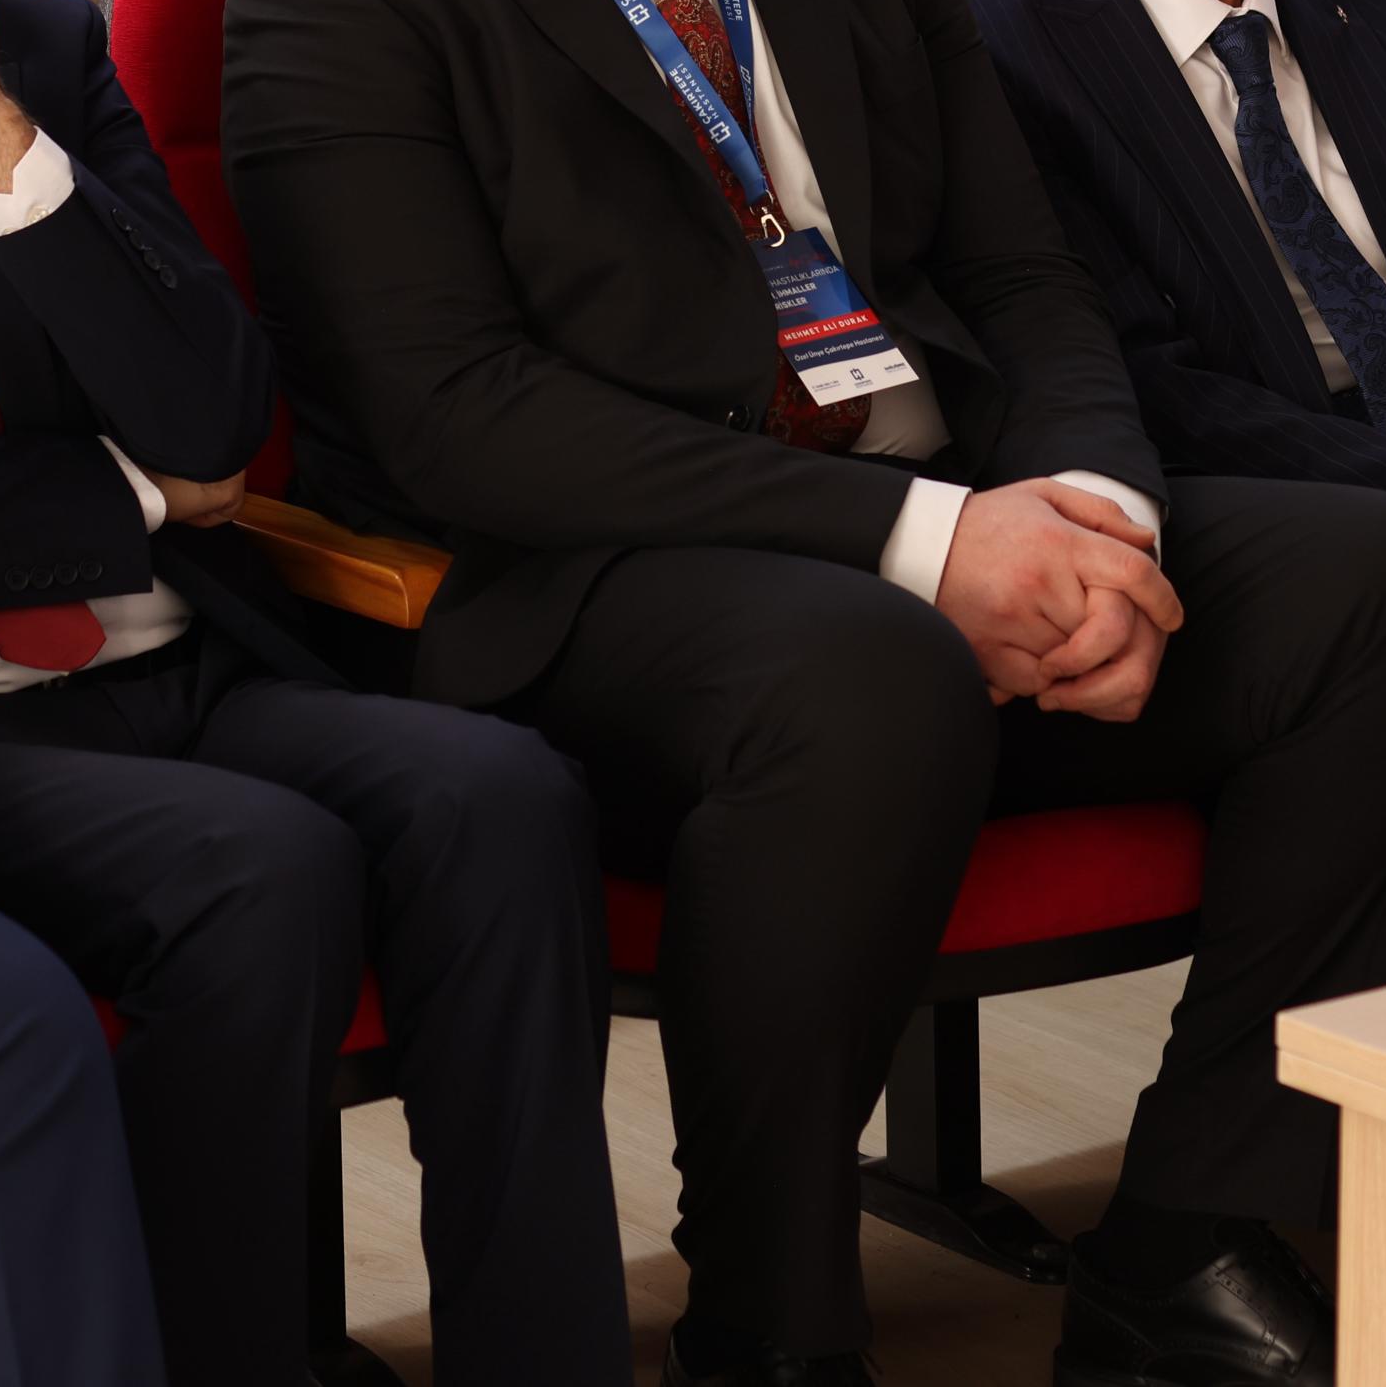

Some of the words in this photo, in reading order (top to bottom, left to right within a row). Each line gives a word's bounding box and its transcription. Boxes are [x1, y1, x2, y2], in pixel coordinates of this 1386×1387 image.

[669, 67, 710, 124] ÇAKIRTEPE
[784, 326, 821, 341] MEHMET
[838, 314, 869, 328] DURAK
